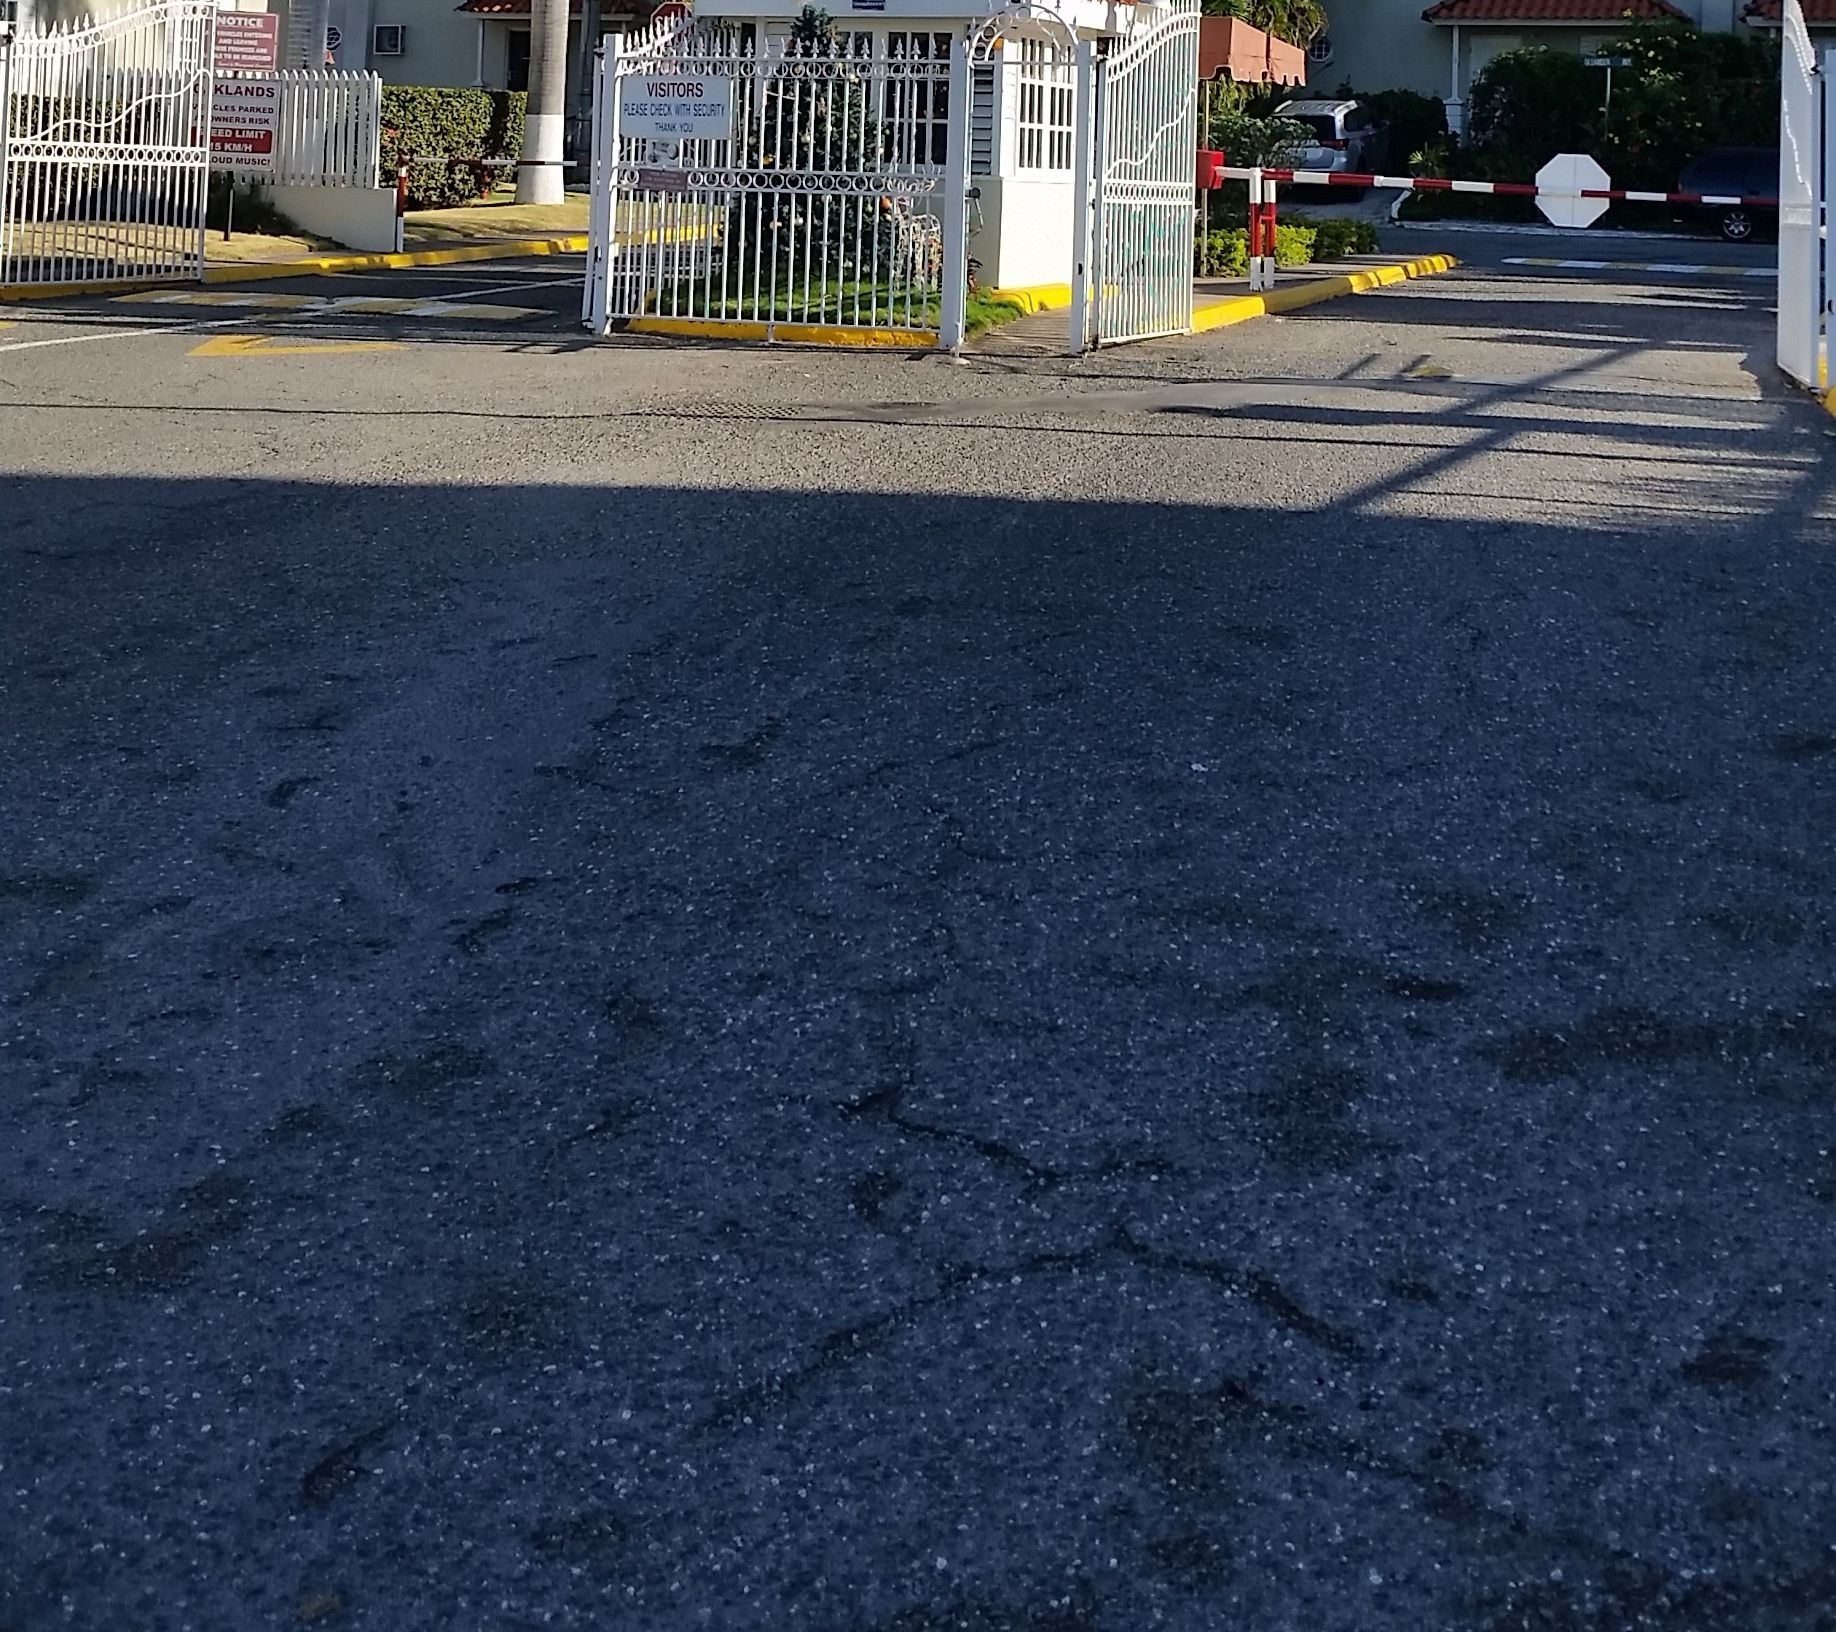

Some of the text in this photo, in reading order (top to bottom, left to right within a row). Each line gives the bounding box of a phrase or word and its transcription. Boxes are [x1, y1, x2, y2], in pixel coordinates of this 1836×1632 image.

[216, 16, 264, 28] NOTICE
[193, 83, 275, 98] OKLANDS
[646, 82, 704, 98] VISITORS
[238, 106, 274, 114] PARKED
[624, 103, 726, 117] PLEASE CHECK WITH SECURITY
[248, 117, 270, 125] RISK
[654, 122, 694, 133] THANK YOU
[235, 129, 266, 139] LIMIT
[210, 142, 253, 153] 15 KM/H
[235, 157, 271, 166] MUSIC!
